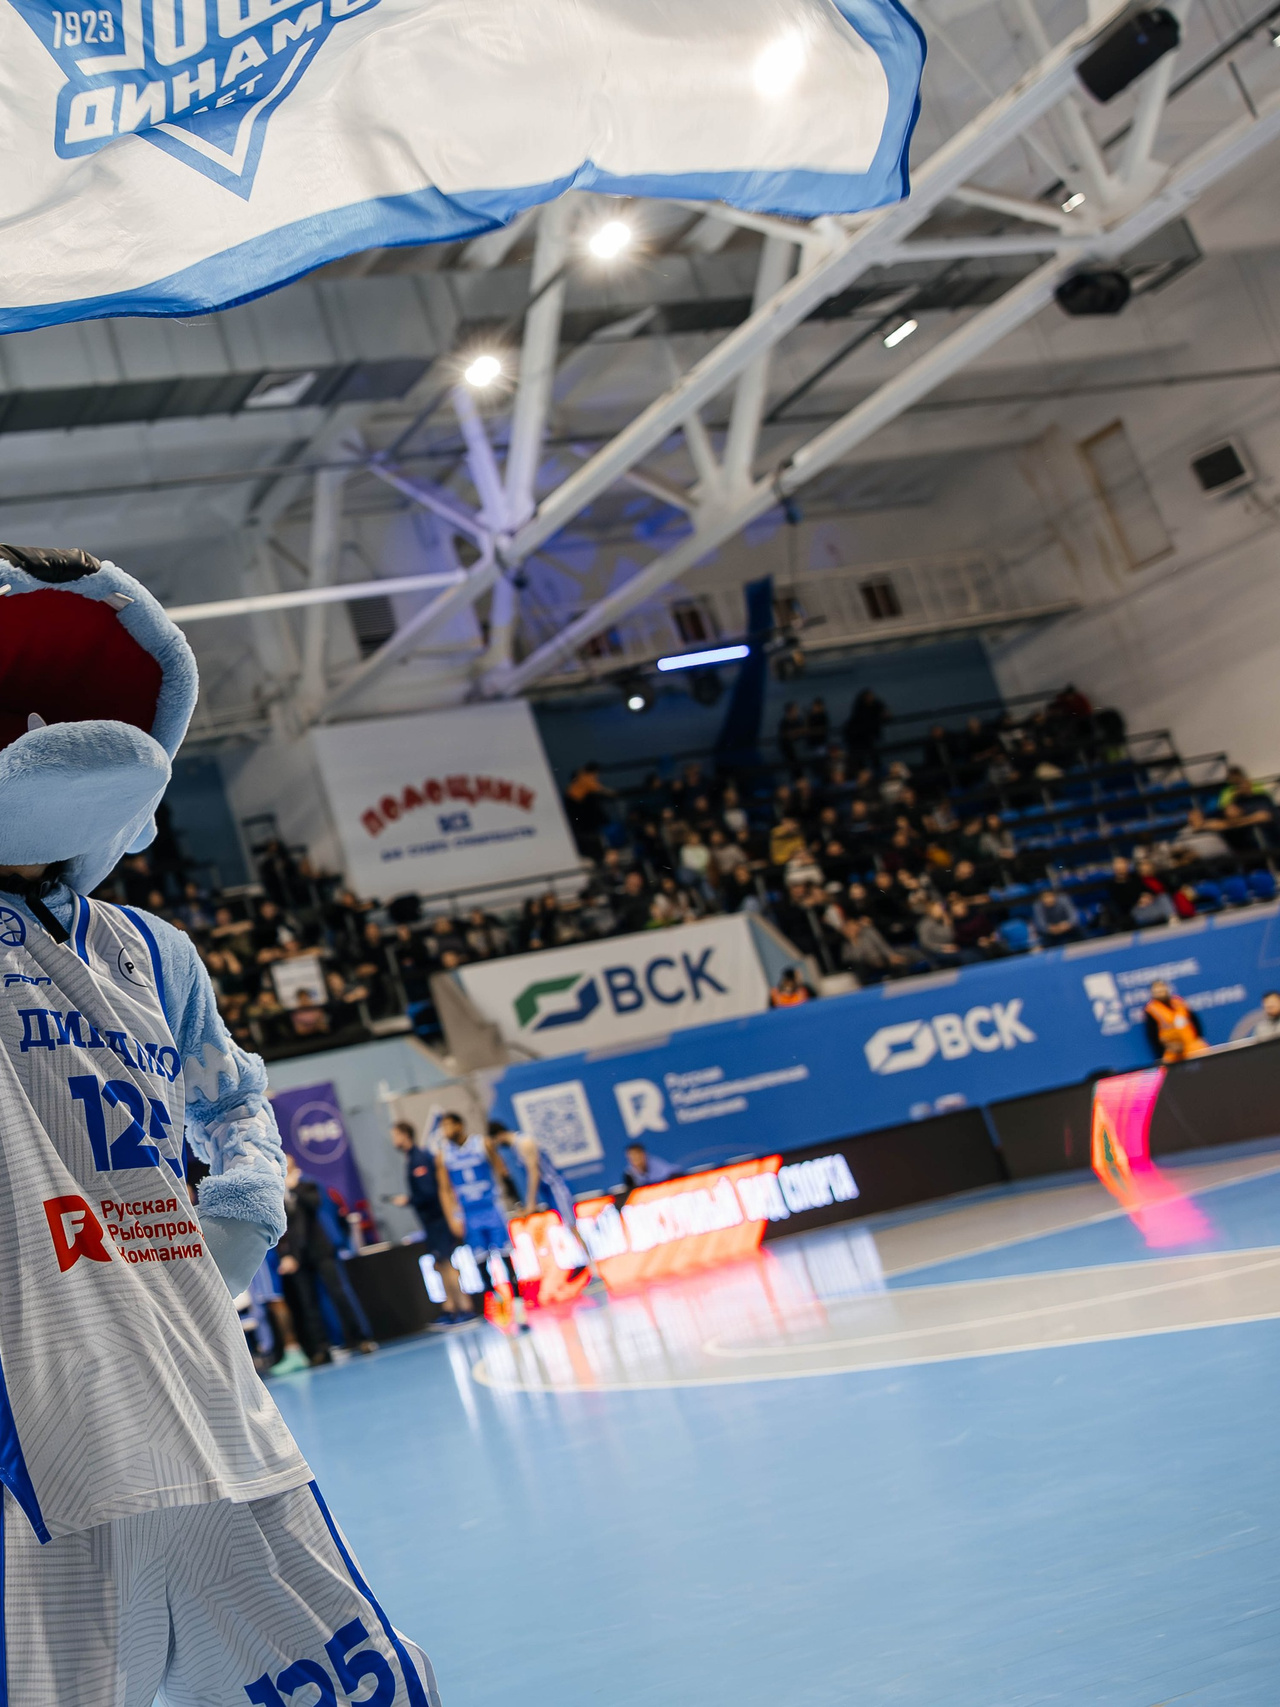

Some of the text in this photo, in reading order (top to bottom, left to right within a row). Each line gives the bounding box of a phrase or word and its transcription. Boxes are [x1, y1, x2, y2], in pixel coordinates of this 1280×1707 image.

[52, 10, 115, 49] 1923
[100, 1198, 178, 1222] Русская
[107, 1219, 204, 1242] Рыбопром
[116, 1243, 203, 1264] Компания
